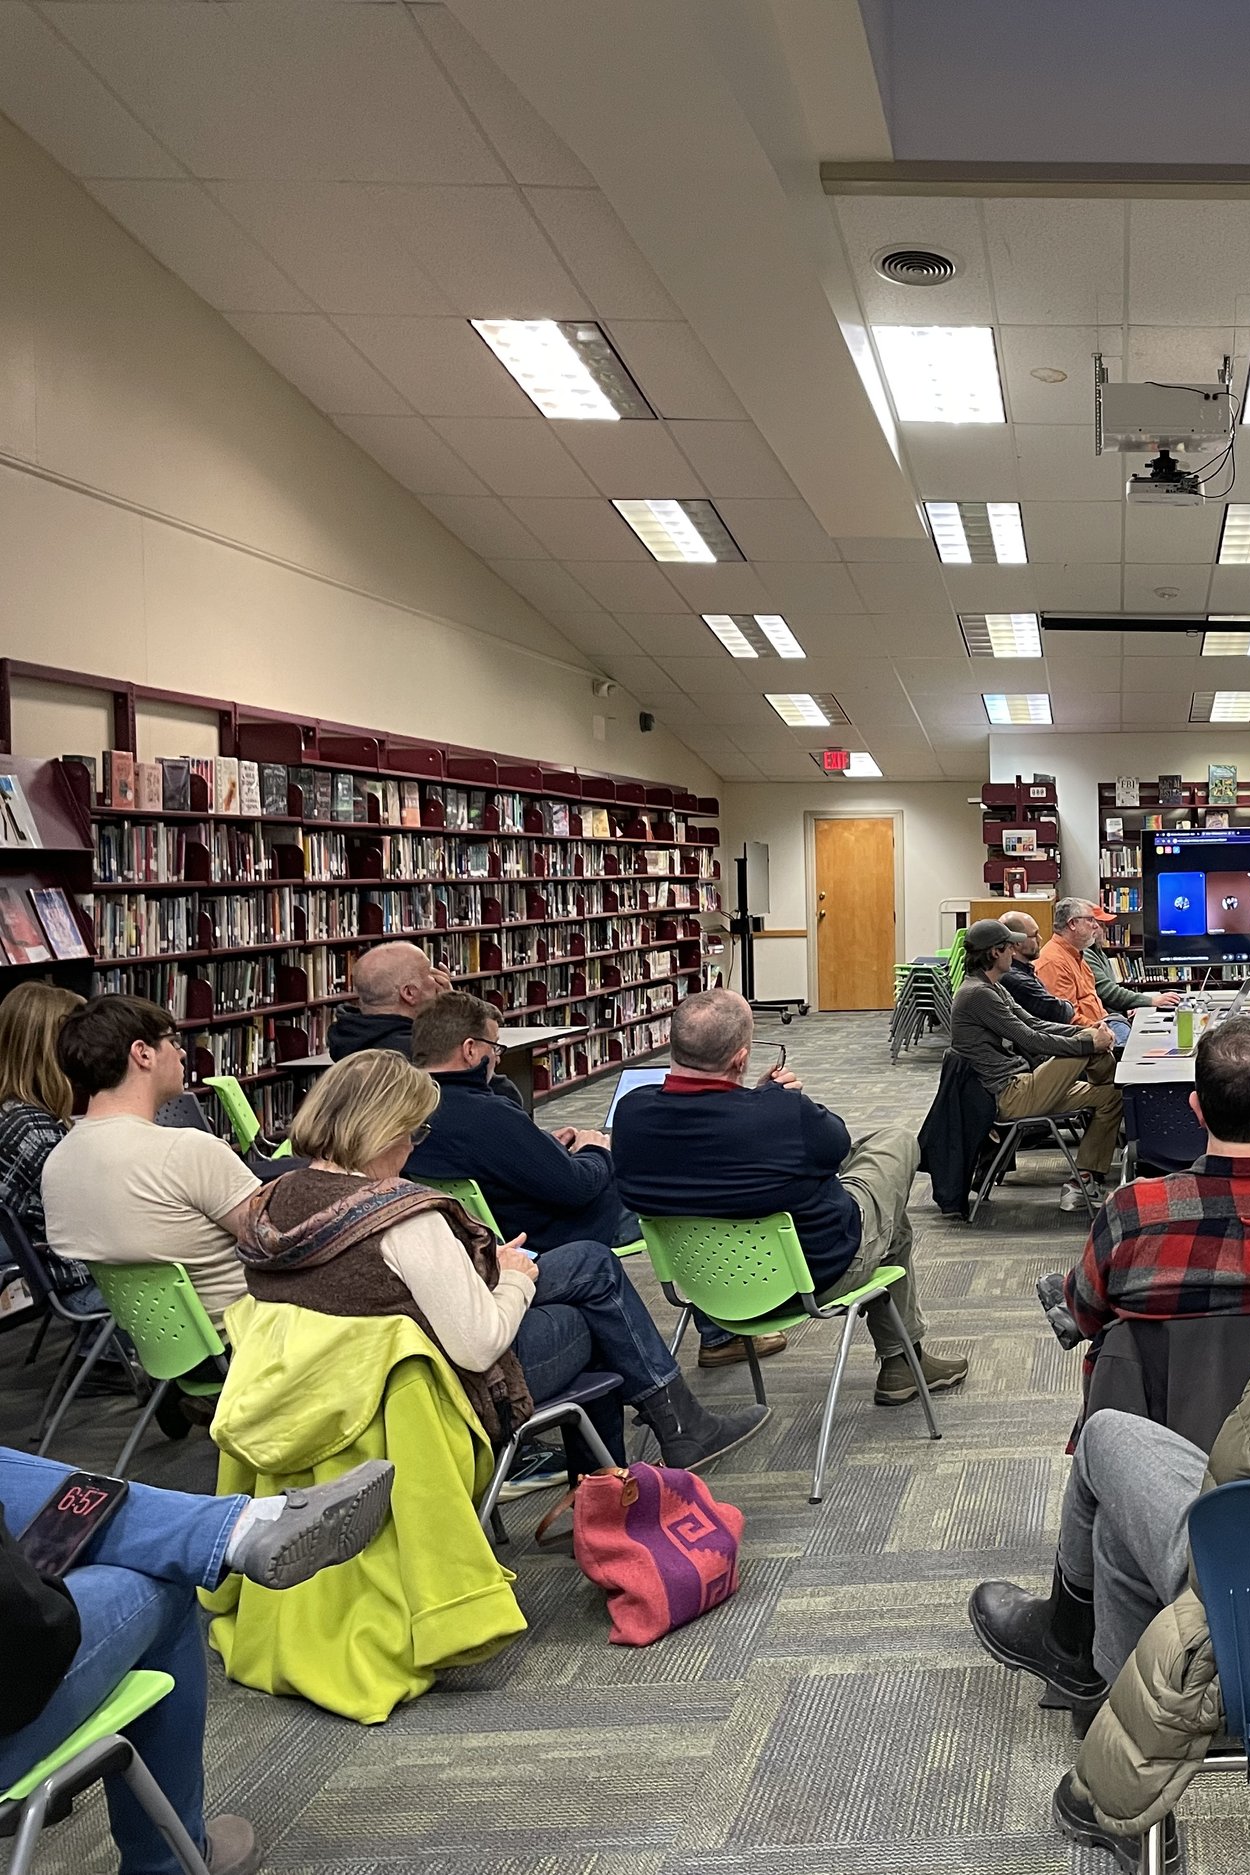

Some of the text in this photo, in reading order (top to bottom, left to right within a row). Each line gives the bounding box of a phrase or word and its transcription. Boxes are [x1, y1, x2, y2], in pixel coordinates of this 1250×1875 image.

[824, 752, 848, 769] EXIT
[1121, 780, 1136, 789] FBI
[58, 1487, 108, 1515] 6:57
